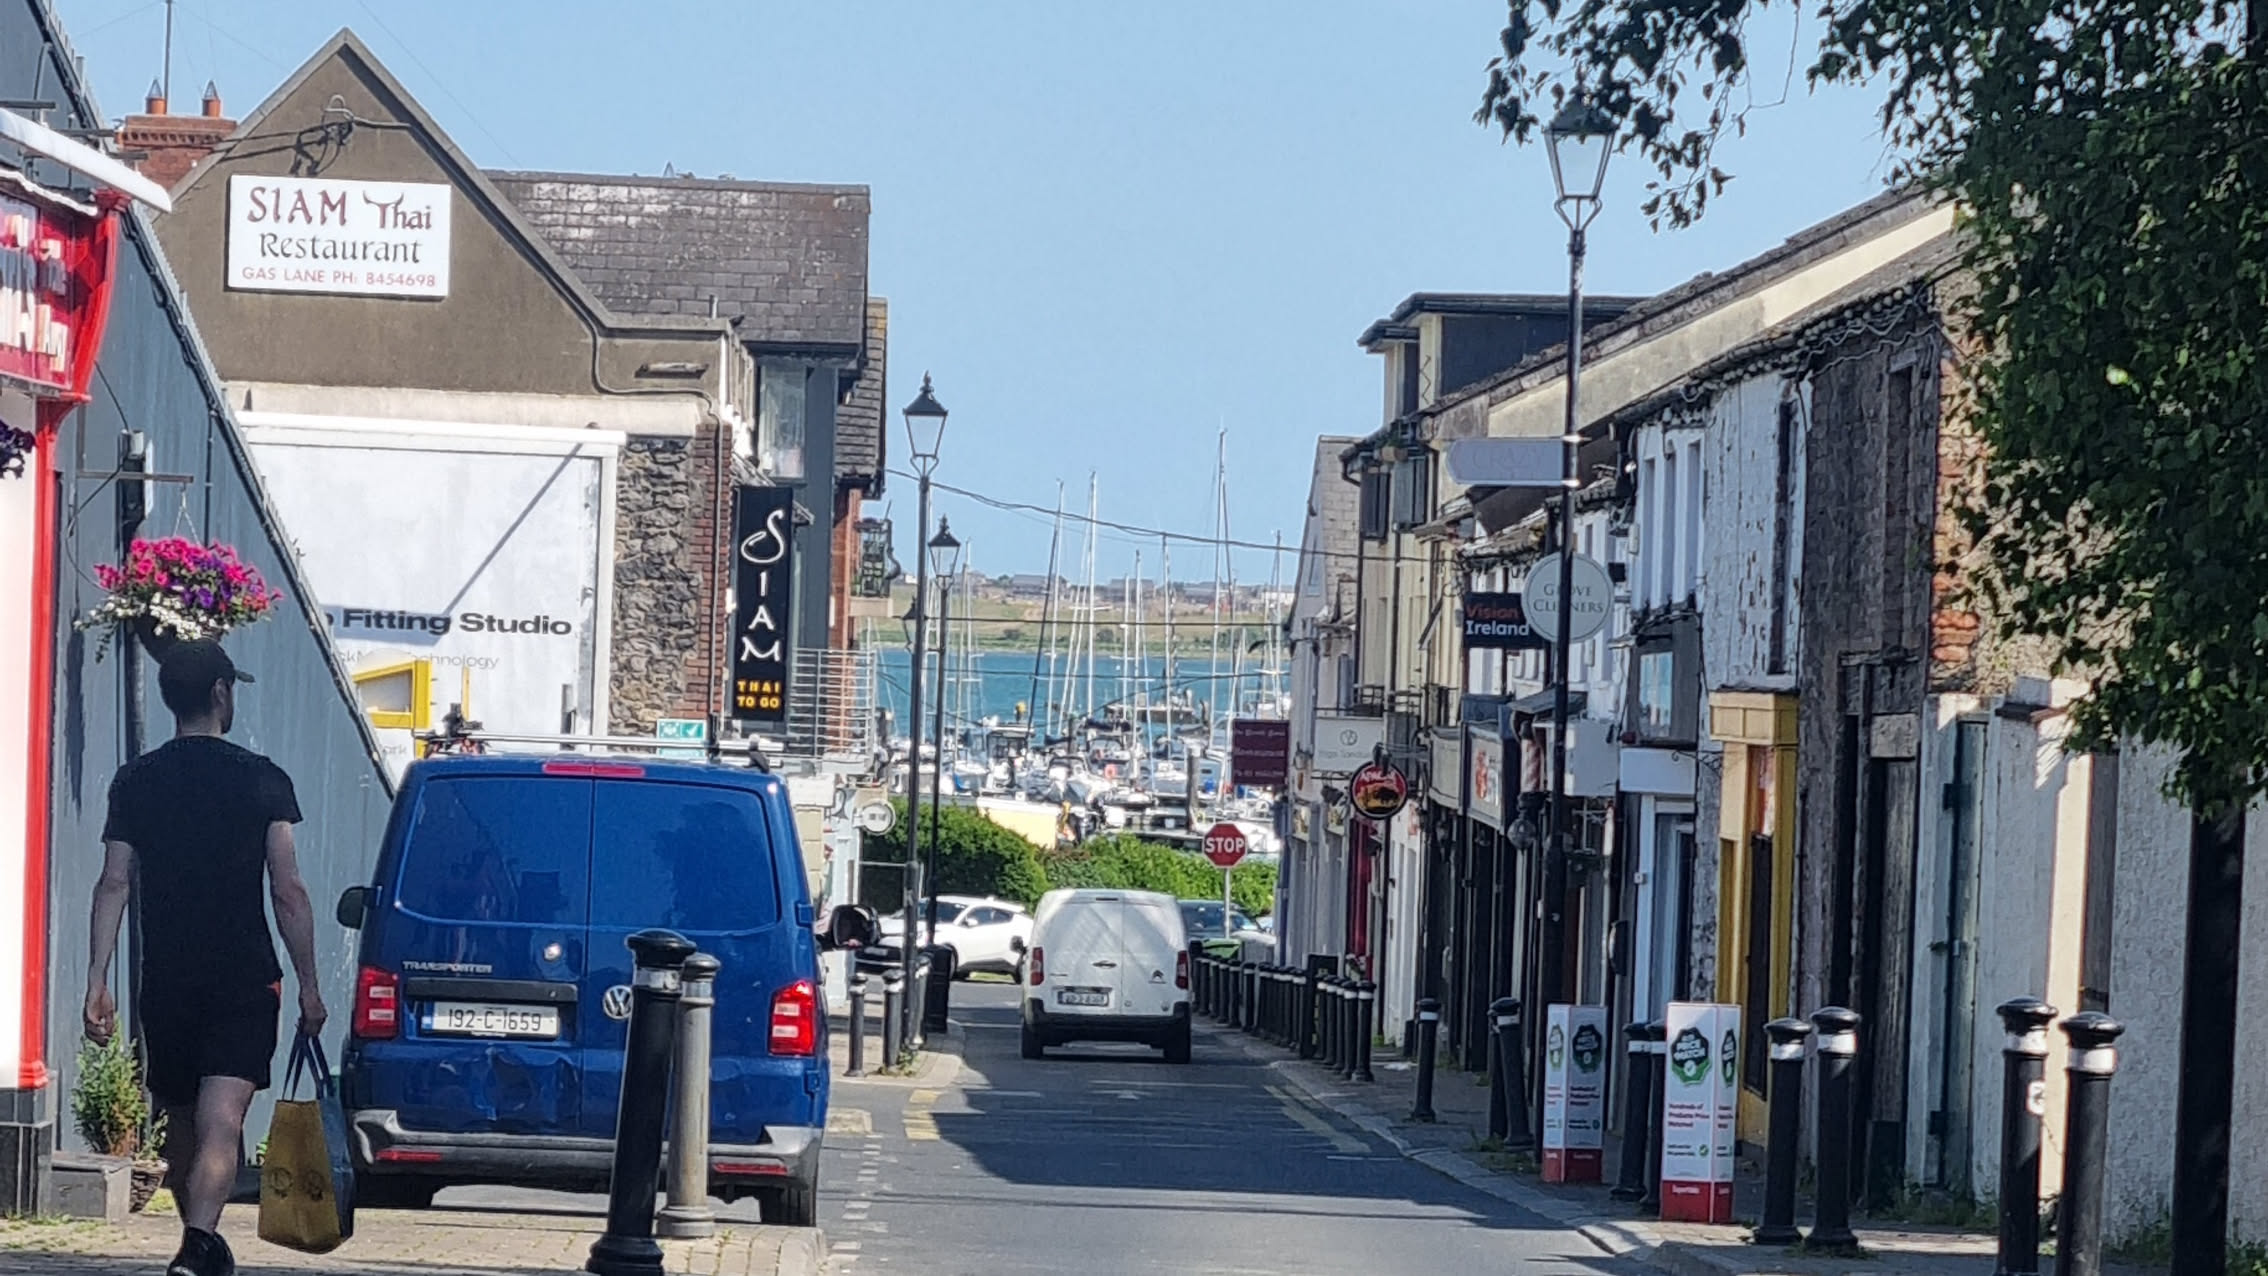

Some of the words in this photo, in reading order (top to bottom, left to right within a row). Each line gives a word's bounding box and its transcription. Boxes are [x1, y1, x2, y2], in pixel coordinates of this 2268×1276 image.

[247, 186, 347, 226] SIAM
[362, 190, 432, 230] Thai
[260, 232, 423, 264] Restaurant
[242, 266, 276, 281] GAS
[284, 269, 326, 283] LANE
[333, 271, 358, 284] PH:
[366, 272, 436, 287] 8454698
[740, 509, 785, 662] SIAM
[1543, 583, 1591, 597] GVE
[1465, 604, 1519, 619] Vision
[1533, 598, 1604, 613] CLENERS
[342, 608, 451, 636] Fitting
[459, 612, 572, 636] Studio
[1465, 620, 1530, 637] Ireland
[737, 680, 781, 693] THAI
[737, 695, 755, 708] TO
[759, 695, 780, 709] GO
[1205, 836, 1245, 854] STOP
[402, 960, 493, 974] TRANSPORTER
[448, 1008, 542, 1032] 192-C-1659
